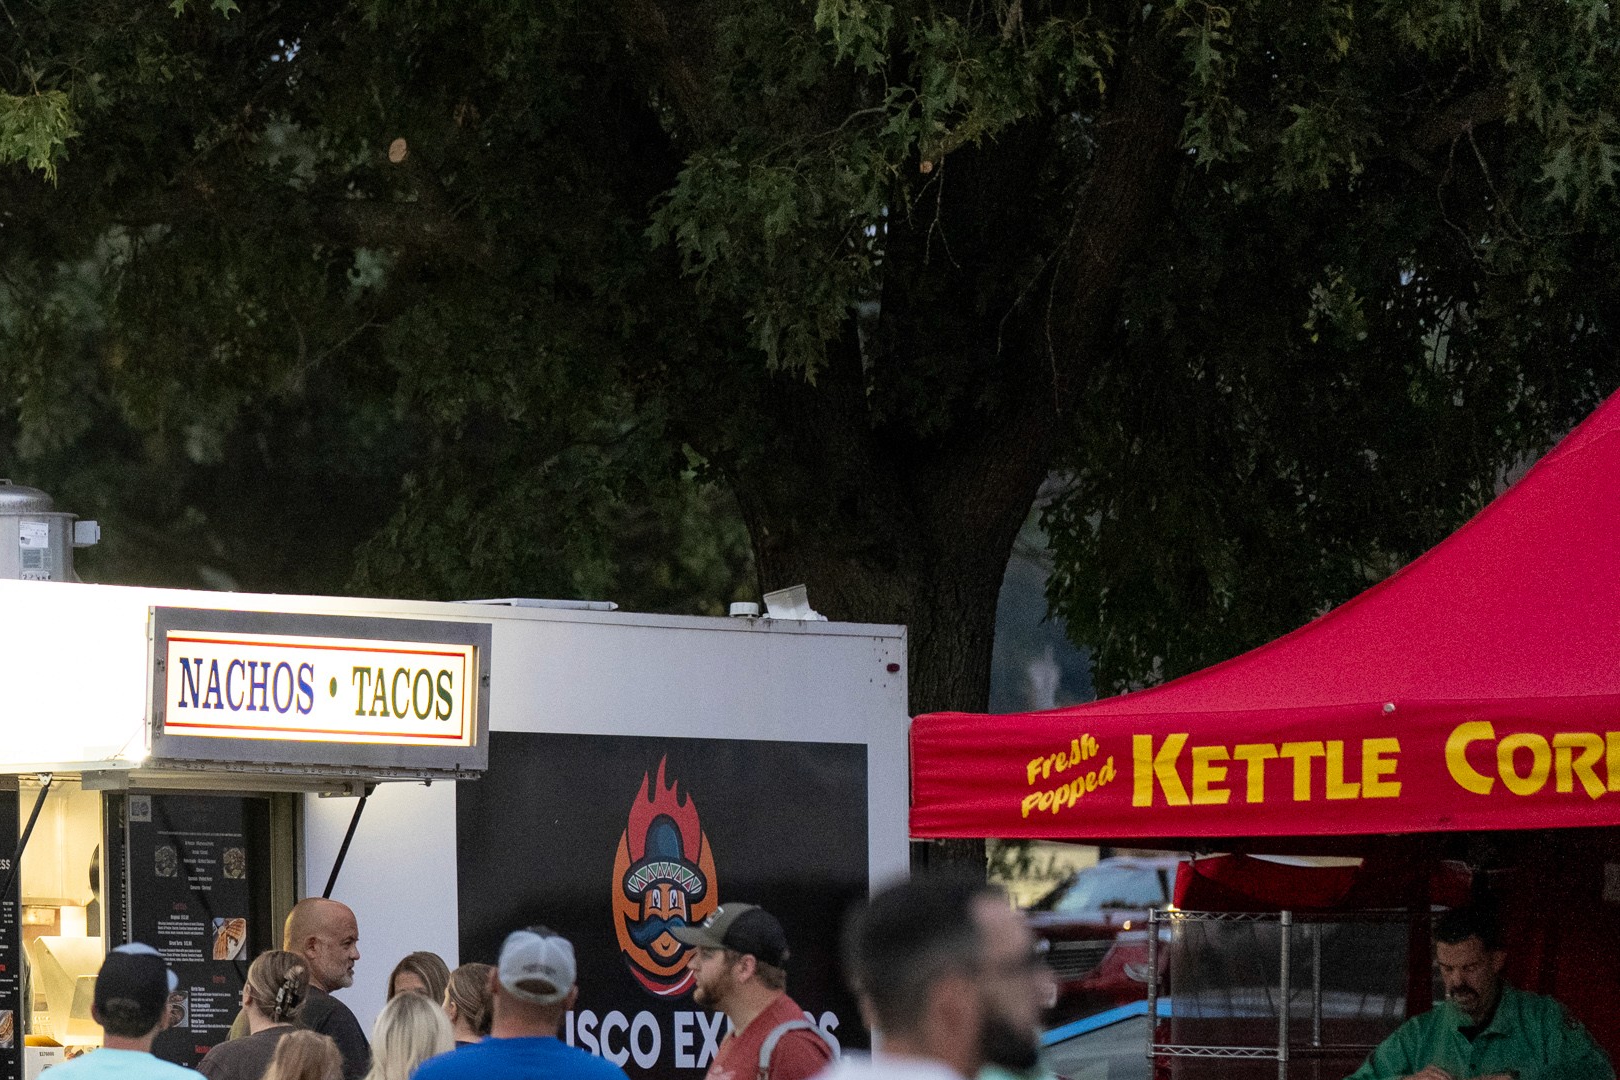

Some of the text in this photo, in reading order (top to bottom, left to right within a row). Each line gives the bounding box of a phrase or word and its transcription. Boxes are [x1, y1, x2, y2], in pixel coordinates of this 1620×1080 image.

[178, 657, 454, 721] NACHOS TACOS
[1021, 755, 1117, 818] Popped
[1026, 733, 1100, 785] Fresh
[1132, 732, 1402, 807] KETTLE
[565, 1009, 662, 1069] ISCO
